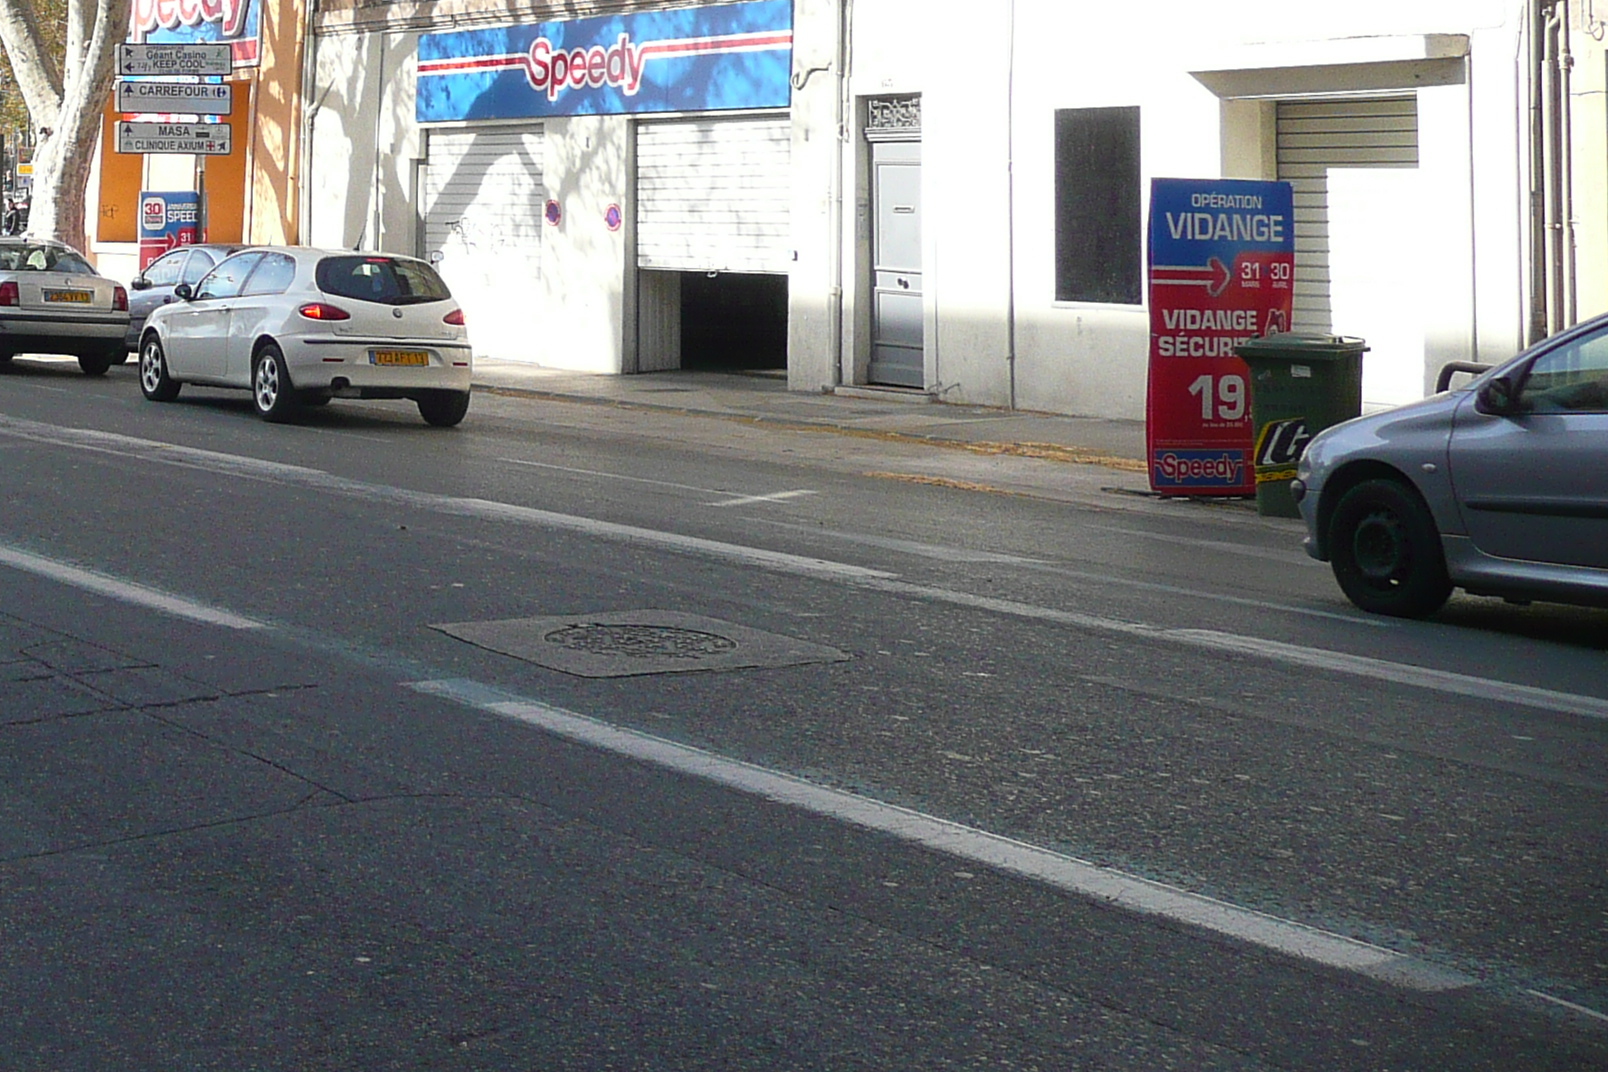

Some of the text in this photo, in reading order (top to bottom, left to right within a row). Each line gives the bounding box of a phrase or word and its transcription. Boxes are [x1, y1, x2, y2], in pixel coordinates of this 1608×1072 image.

[176, 50, 207, 60] Casino
[153, 60, 177, 68] KEEP
[179, 60, 206, 69] COOL
[530, 35, 644, 99] Speedy
[139, 86, 208, 96] CARREFOUR
[158, 126, 190, 136] MASA
[135, 140, 204, 151] CLINIQUE AXIUM
[1192, 191, 1262, 209] OPÉRATION
[1166, 212, 1284, 242] VIDANGE
[180, 232, 191, 242] 31
[1241, 262, 1290, 280] 31 30
[1162, 309, 1258, 331] VIDANGE
[1162, 453, 1239, 484] Speedy
